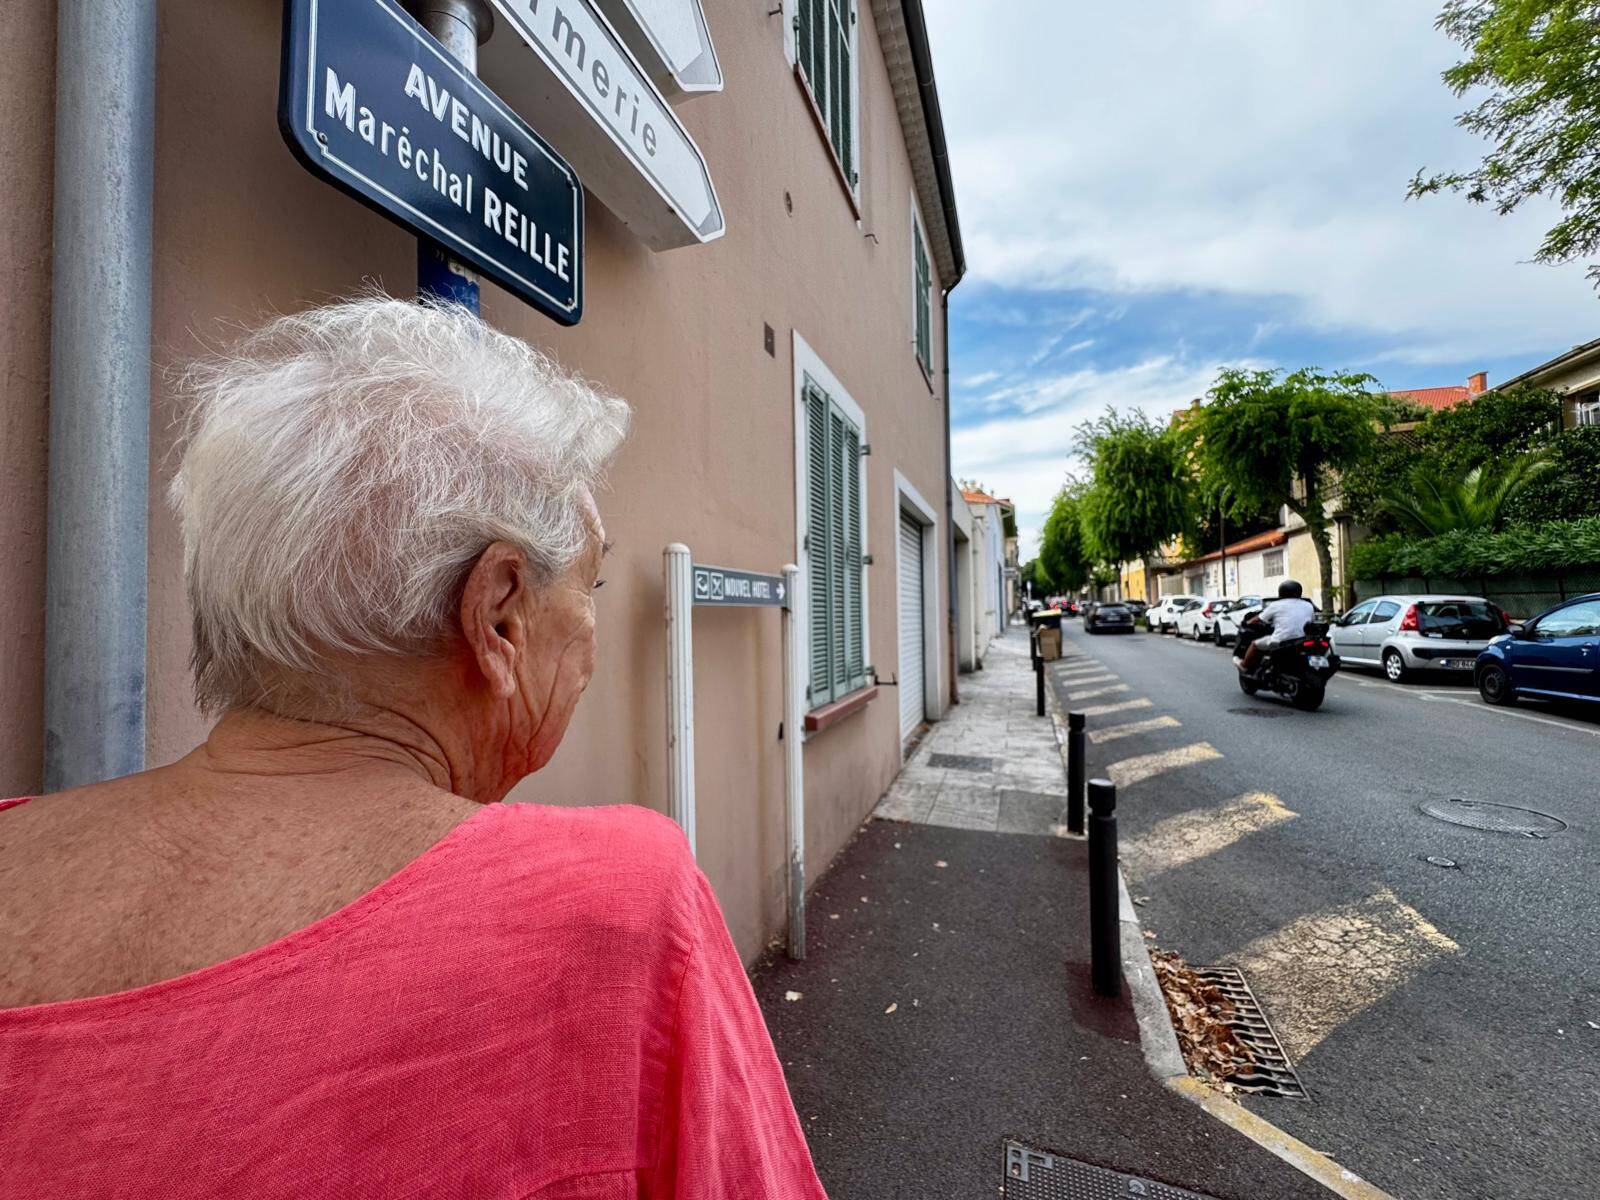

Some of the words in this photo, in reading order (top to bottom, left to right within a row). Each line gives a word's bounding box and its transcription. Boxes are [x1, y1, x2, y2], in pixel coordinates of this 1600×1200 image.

[325, 66, 472, 214] Maréchal
[484, 186, 570, 283] REILLE
[404, 62, 529, 191] AVENUE
